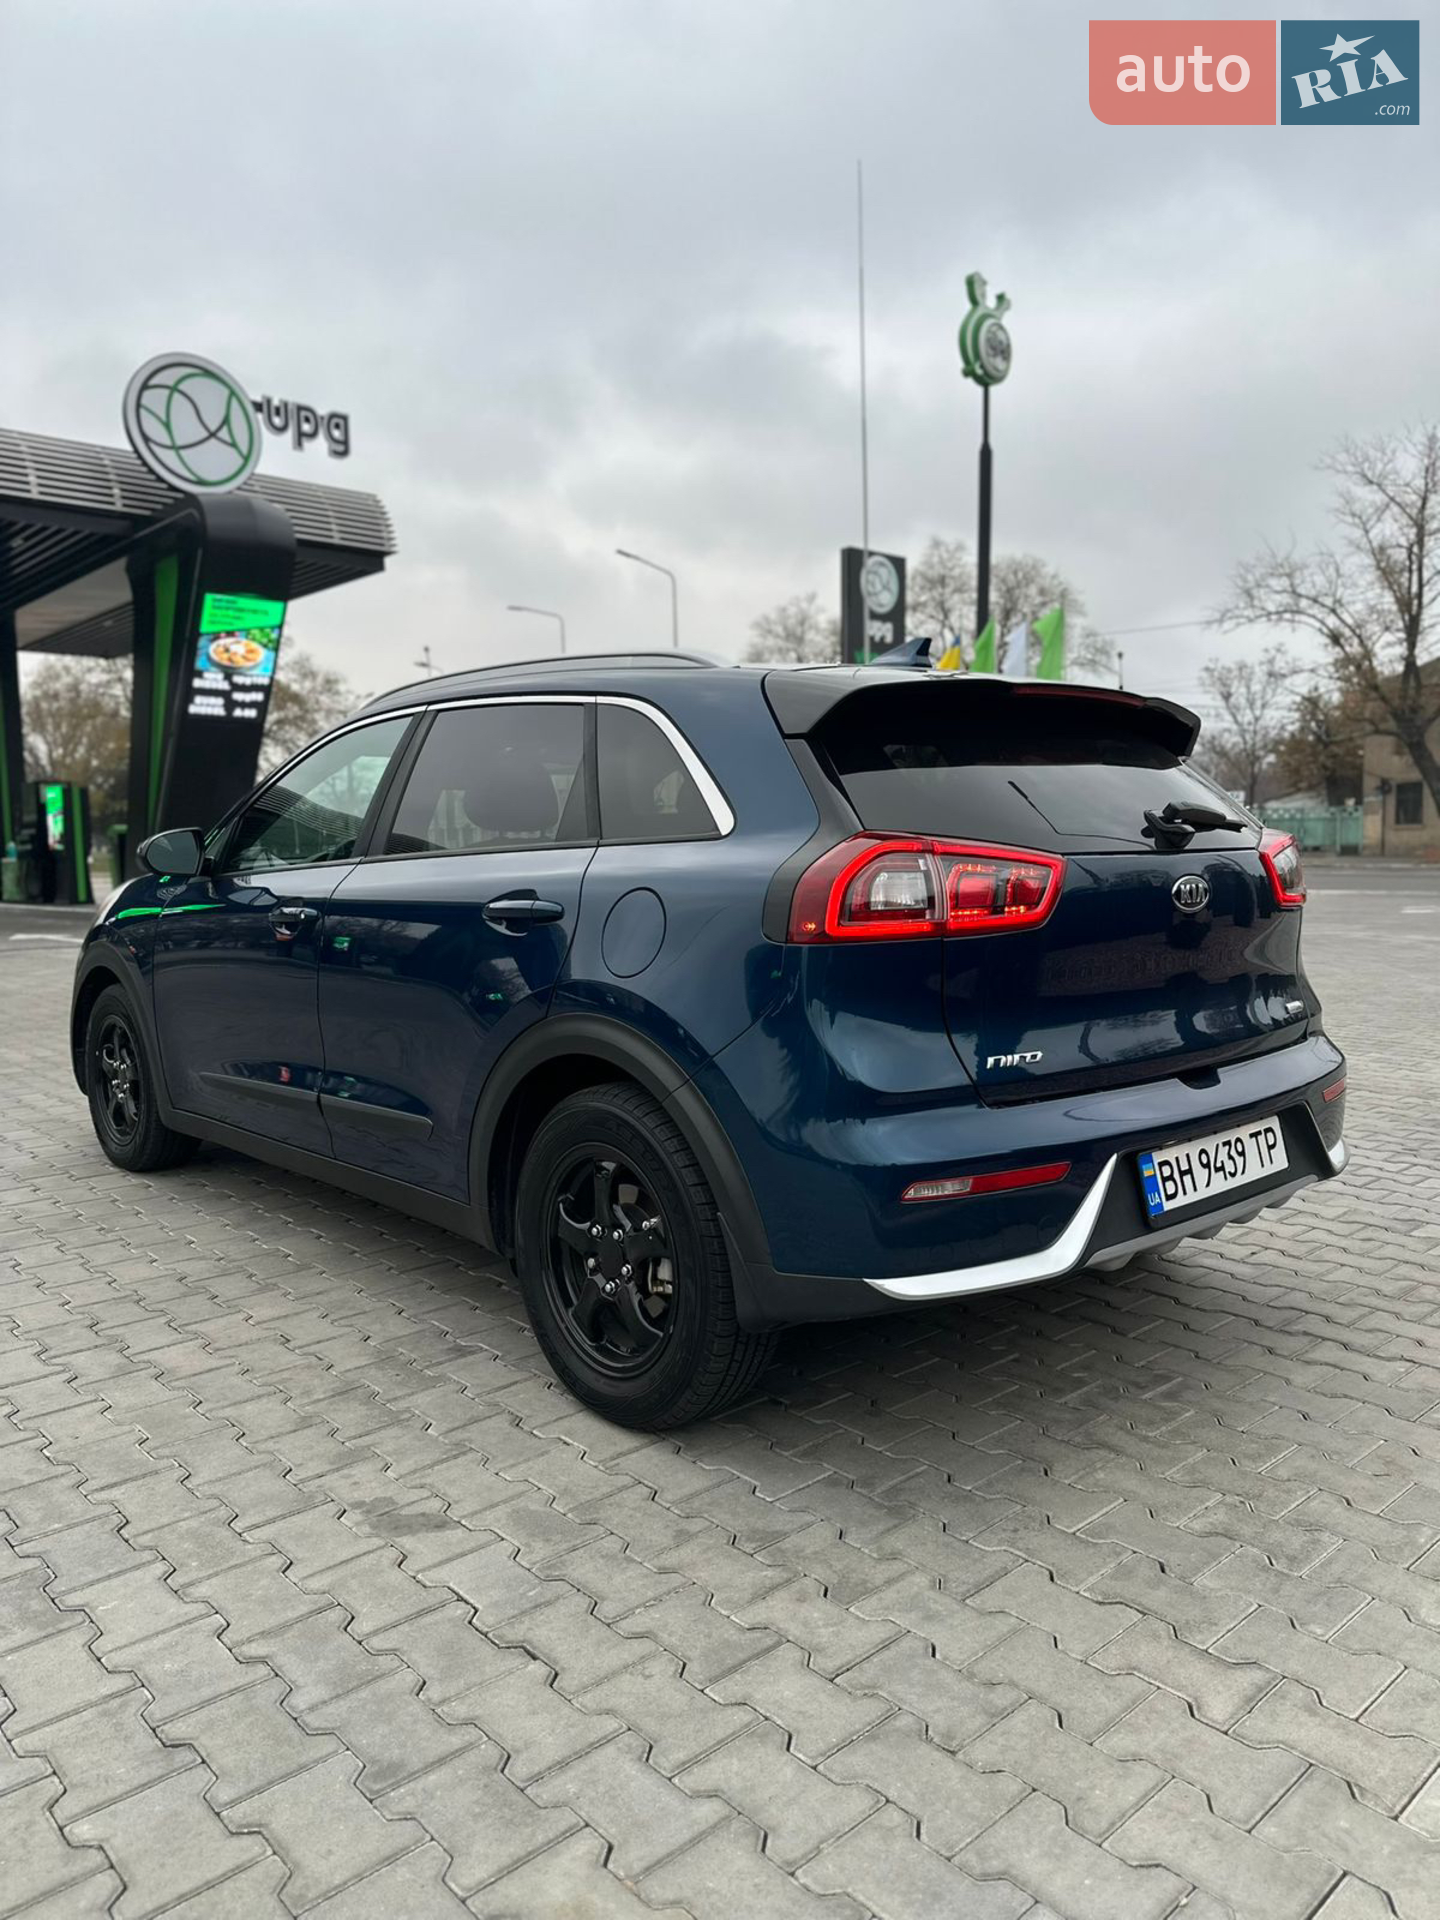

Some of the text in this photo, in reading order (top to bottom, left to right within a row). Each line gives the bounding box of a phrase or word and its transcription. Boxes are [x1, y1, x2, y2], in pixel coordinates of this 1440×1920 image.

[261, 395, 350, 459] upg
[1180, 884, 1207, 904] KIA
[1157, 1126, 1277, 1202] BH 9439 TP
[1147, 1192, 1161, 1206] UA
